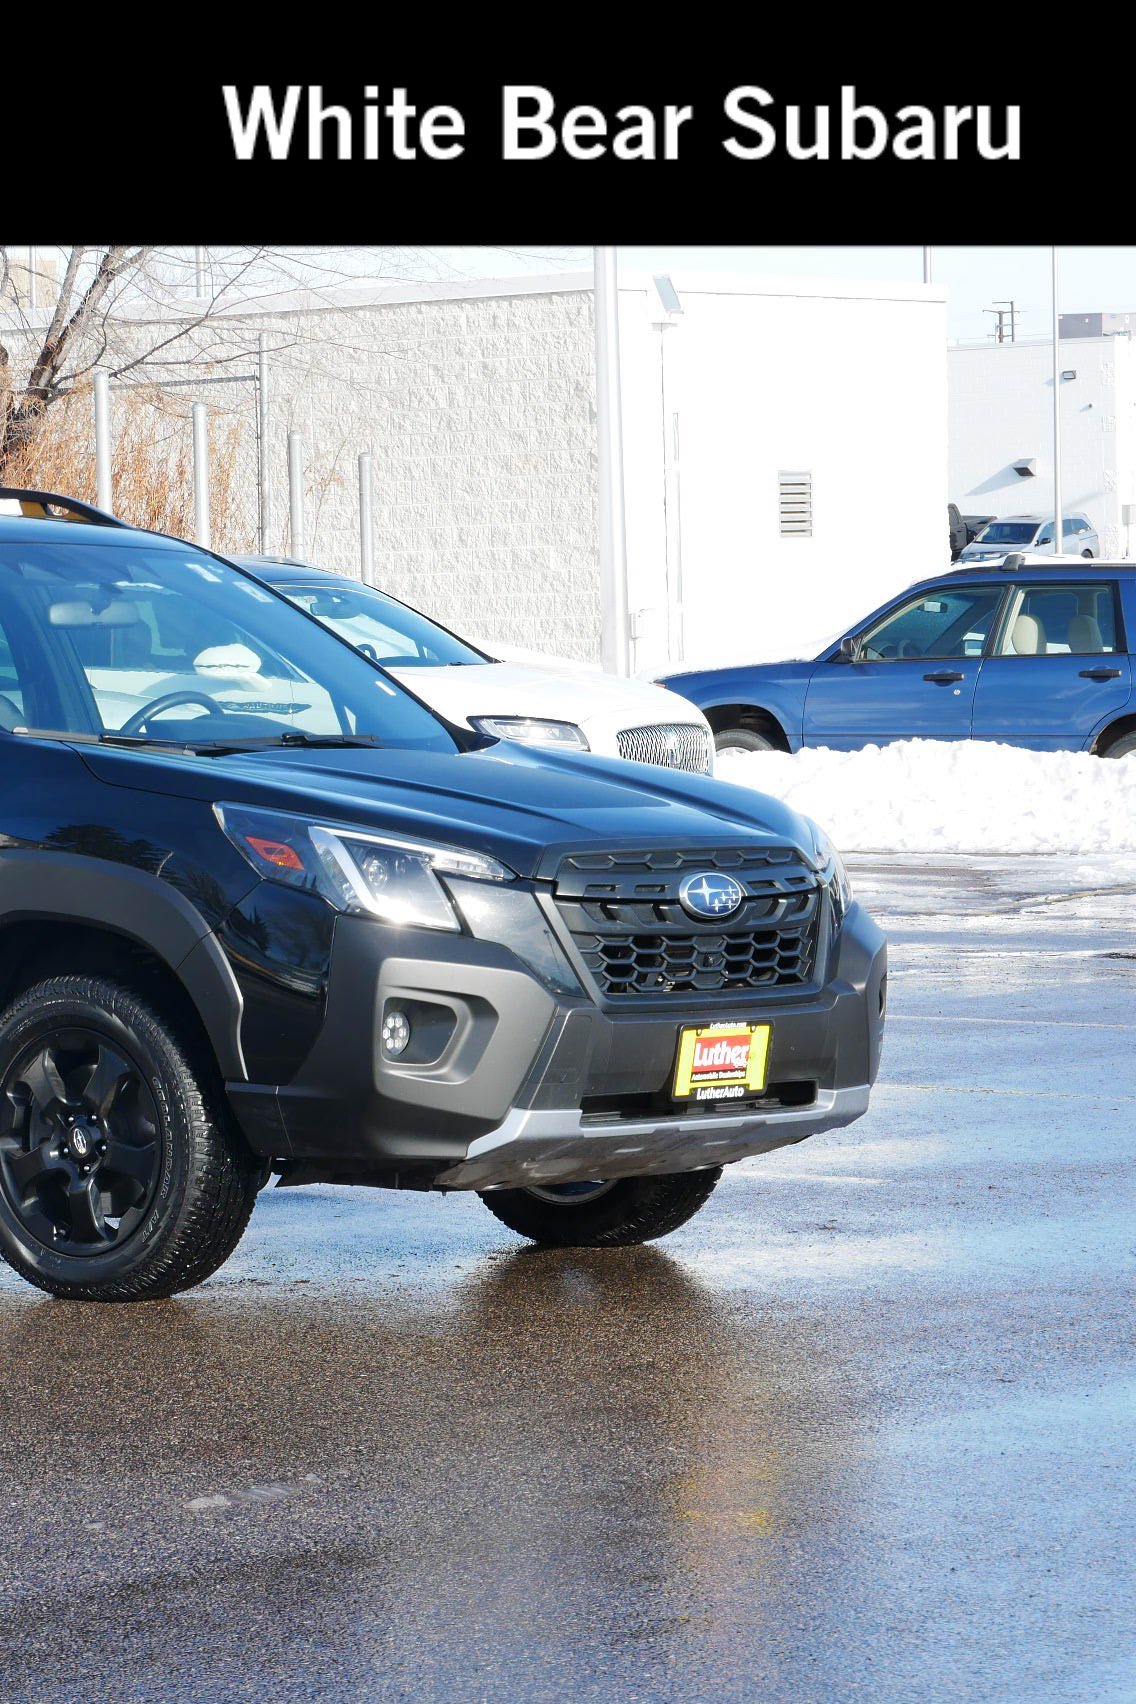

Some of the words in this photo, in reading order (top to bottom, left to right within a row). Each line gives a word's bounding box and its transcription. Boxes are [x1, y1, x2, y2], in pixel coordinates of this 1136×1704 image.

[693, 1041, 750, 1066] Luther
[696, 1085, 745, 1101] LutherAuto
[152, 1077, 173, 1199] GEOLANDAR
